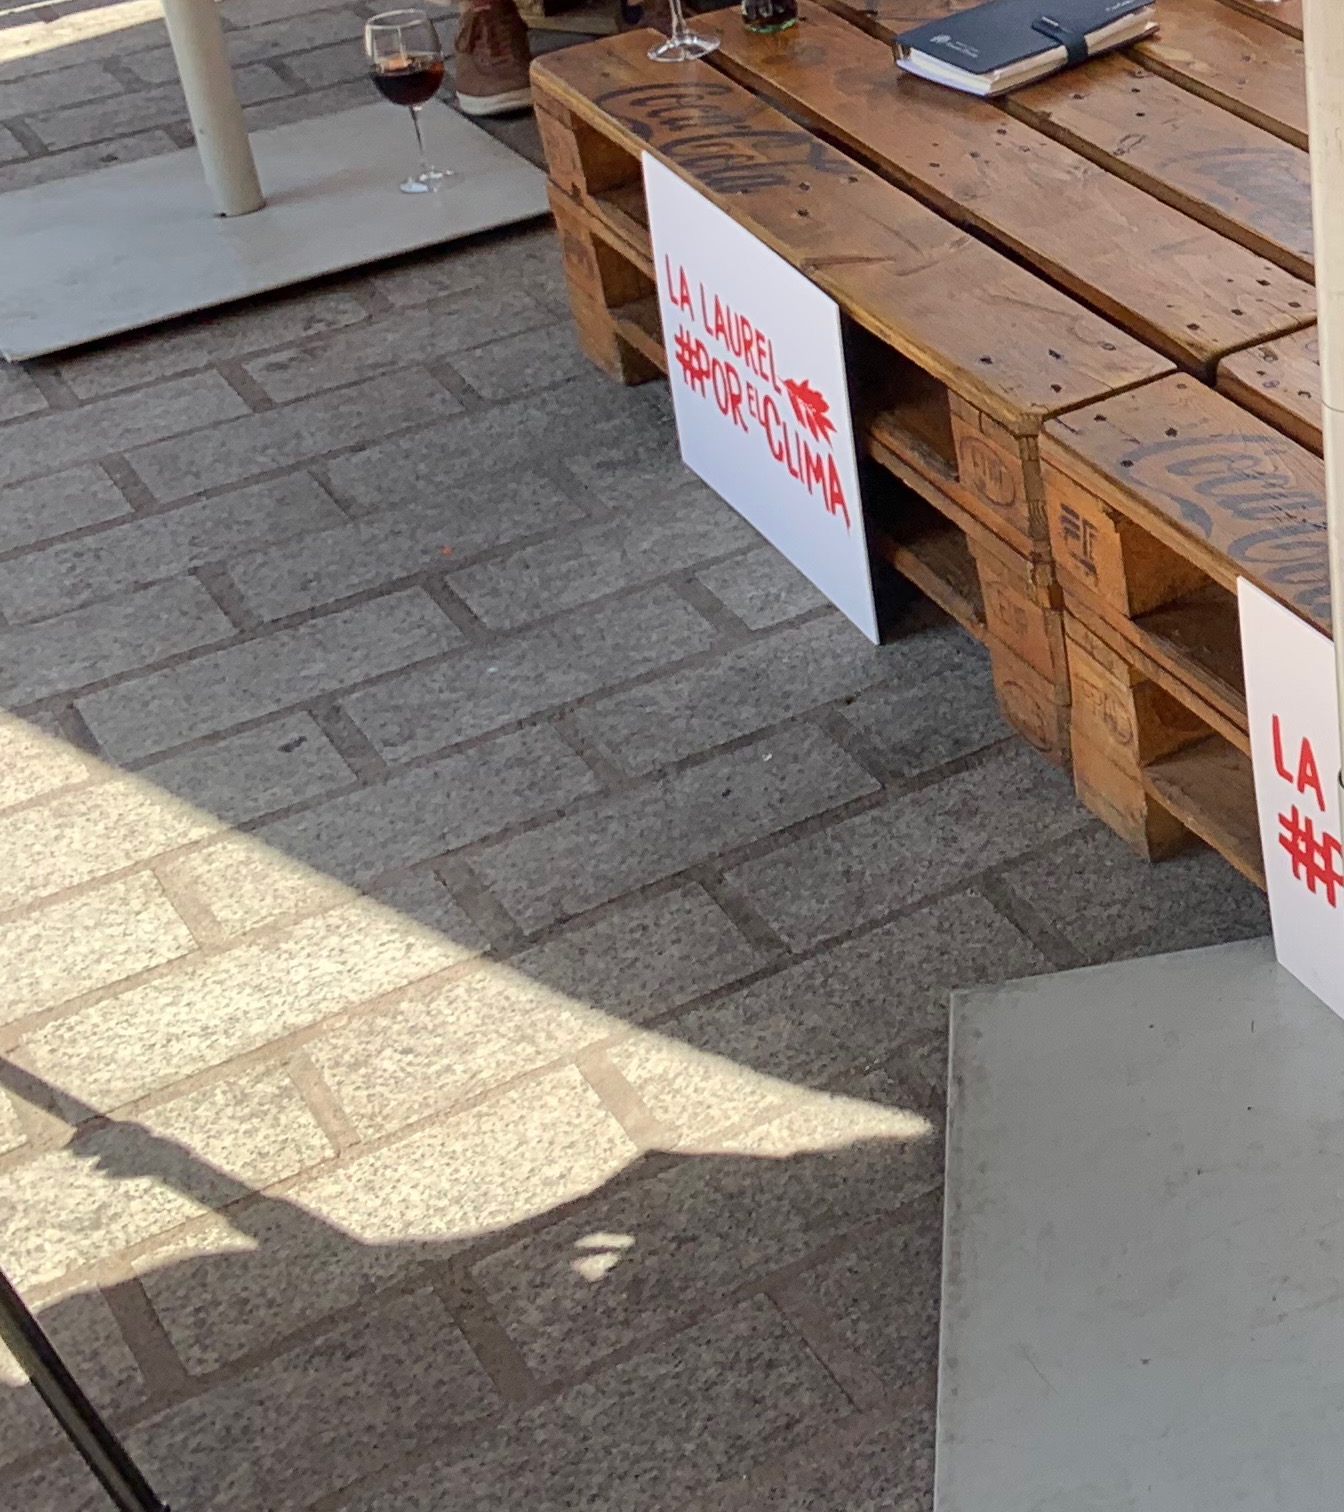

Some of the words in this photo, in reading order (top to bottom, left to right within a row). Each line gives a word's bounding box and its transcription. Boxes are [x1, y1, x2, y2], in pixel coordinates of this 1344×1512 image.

[665, 253, 695, 322] LA
[700, 282, 783, 396] LAUREL
[674, 324, 749, 433] #POR
[747, 381, 766, 429] EL
[764, 397, 852, 536] CLIMA
[1272, 714, 1326, 813] LA
